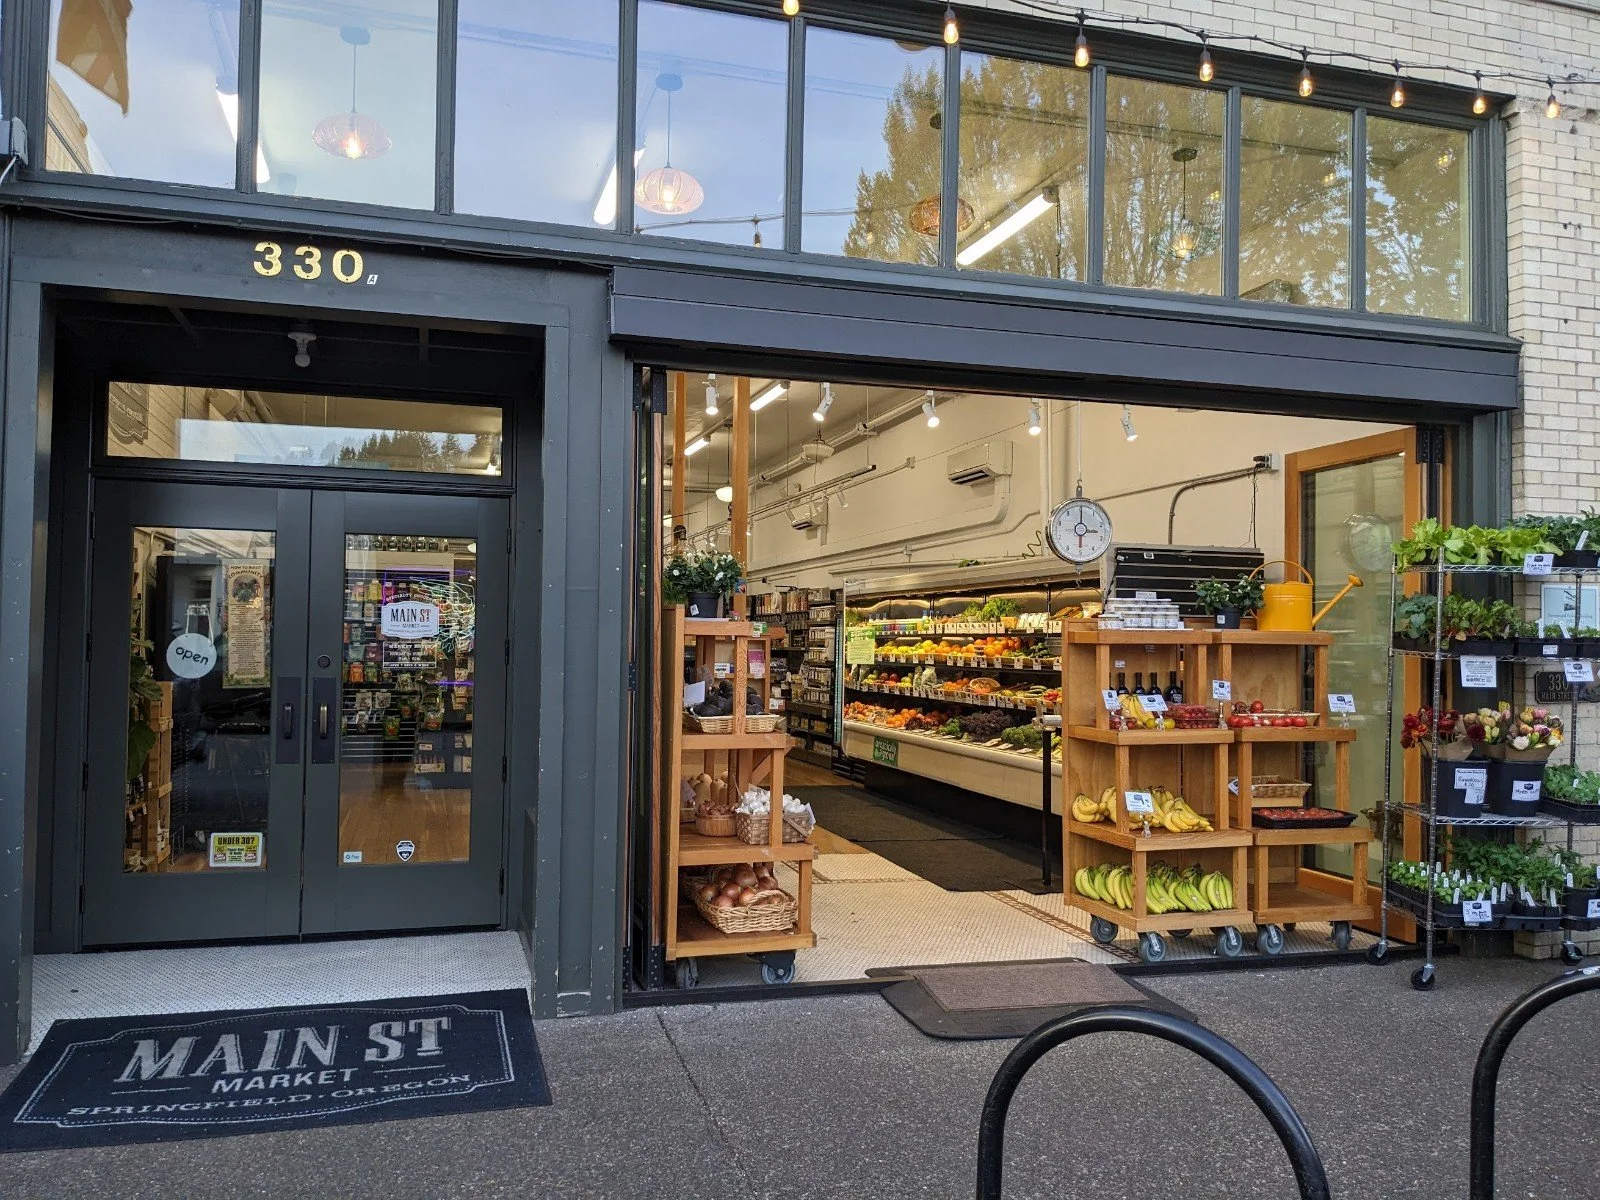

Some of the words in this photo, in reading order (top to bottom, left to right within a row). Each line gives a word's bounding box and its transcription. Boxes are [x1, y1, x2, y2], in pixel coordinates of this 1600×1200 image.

[253, 241, 364, 284] 330
[229, 569, 264, 579] COMMUNITY
[390, 608, 417, 622] MAIN
[175, 646, 209, 665] open
[1548, 674, 1568, 691] 330
[1541, 692, 1556, 700] MAIN
[217, 836, 240, 845] UNDER
[240, 836, 255, 845] 30?
[113, 1025, 345, 1083] MAIN
[364, 1016, 451, 1063] ST
[211, 1068, 359, 1094] MARKET
[66, 1094, 312, 1115] SPRINGFIELD
[331, 1074, 471, 1098] OREGON
